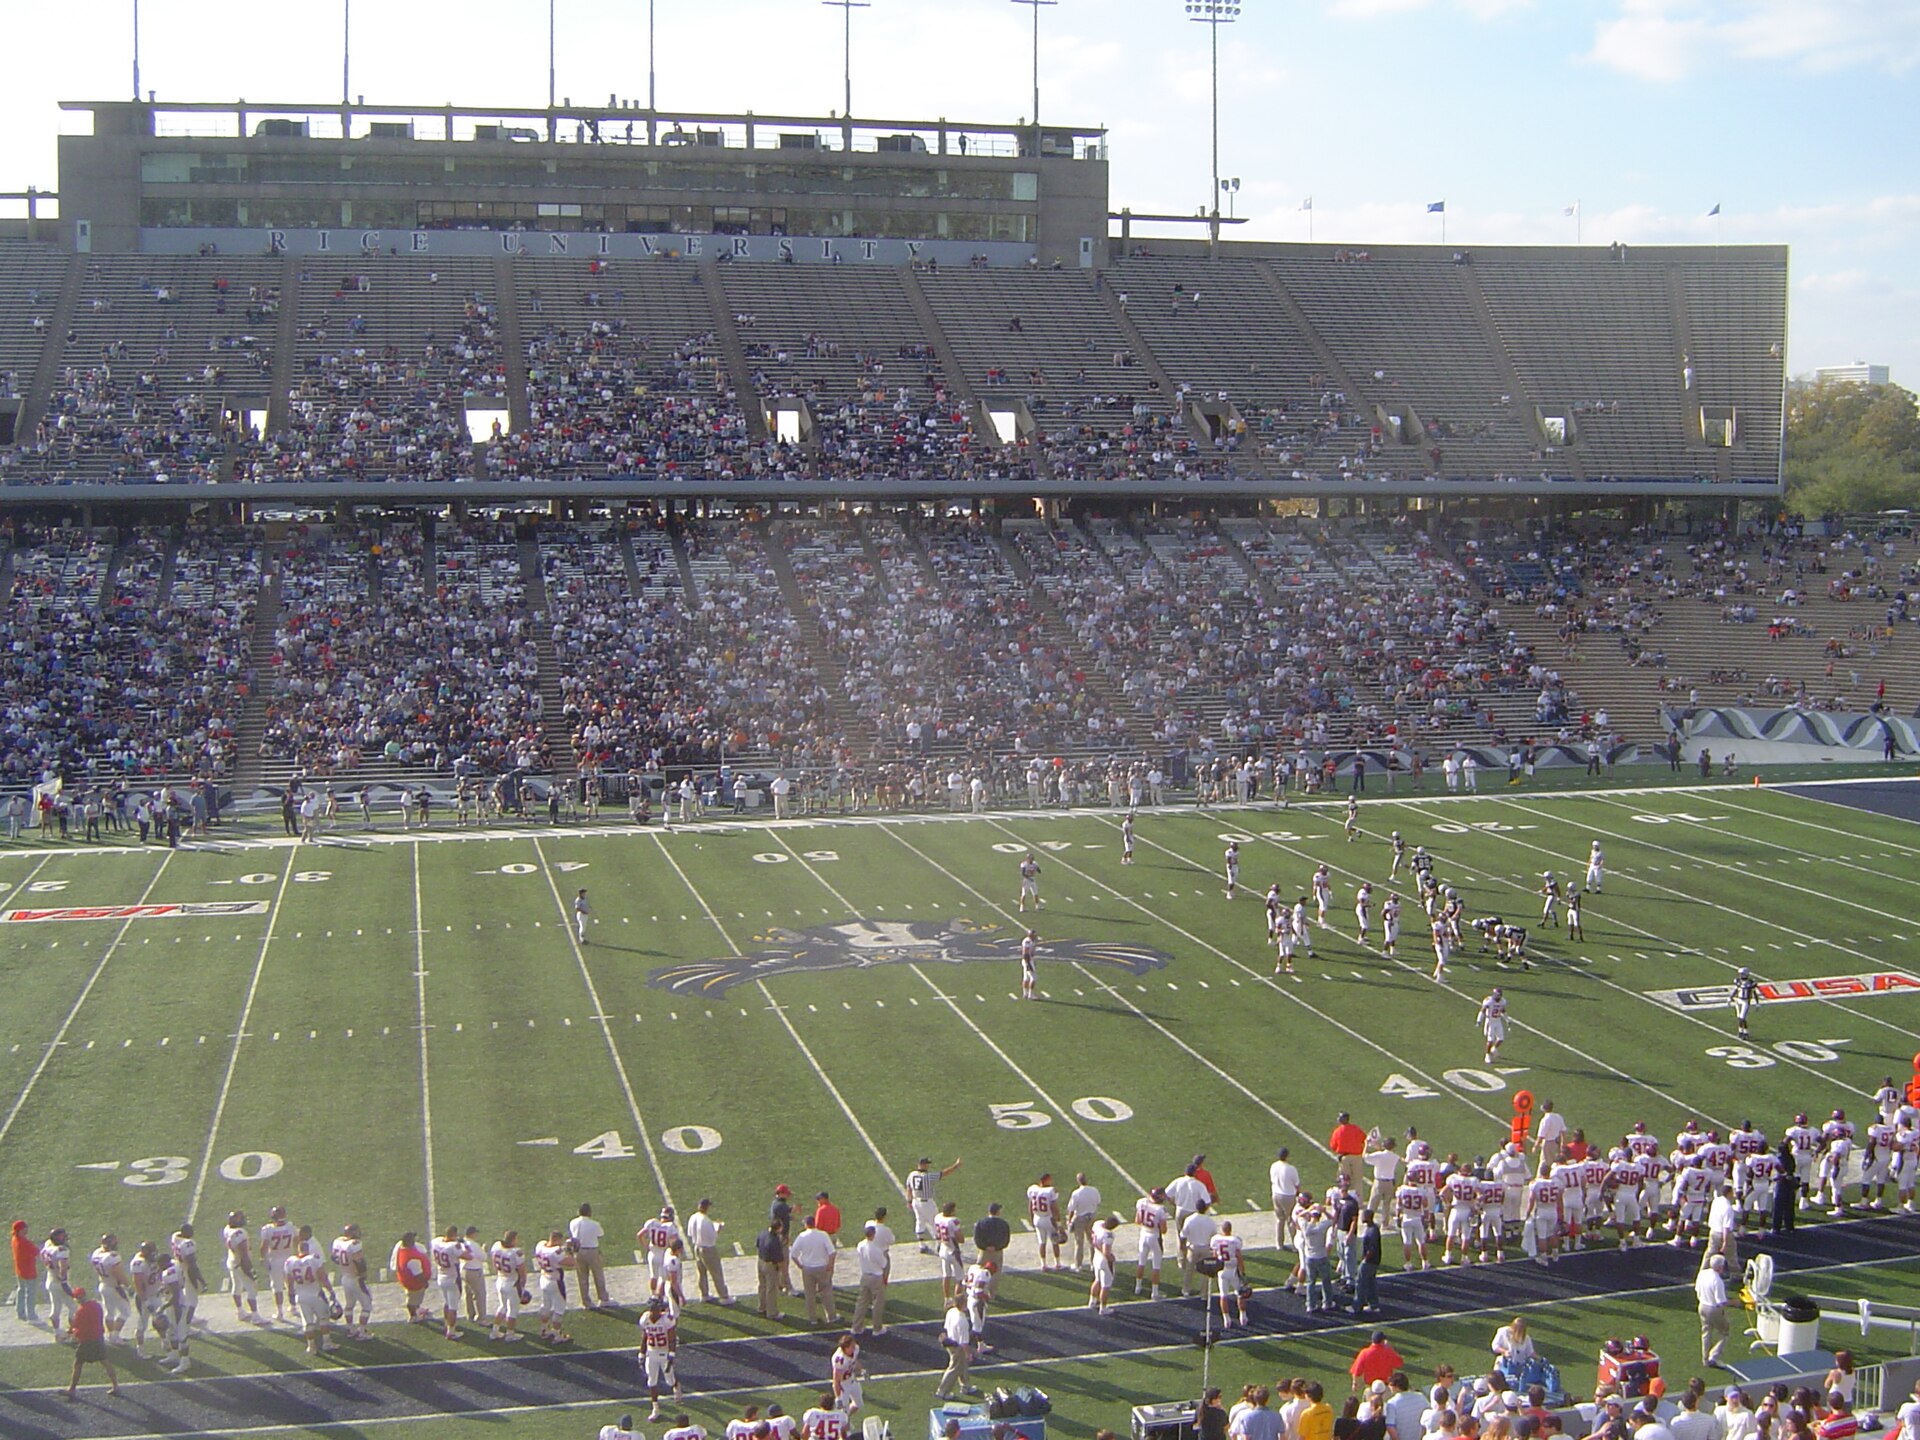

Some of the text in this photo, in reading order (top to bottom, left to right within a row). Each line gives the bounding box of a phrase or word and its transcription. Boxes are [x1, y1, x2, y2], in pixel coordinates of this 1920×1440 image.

[267, 230, 925, 260] RICE UNIVERSITY
[1704, 1040, 1839, 1069] 30
[1378, 1068, 1507, 1099] 40
[987, 1096, 1134, 1131] 50
[572, 1125, 723, 1159] 40
[123, 1151, 284, 1186] 30
[1709, 1151, 1726, 1166] 43
[1140, 1208, 1154, 1228] 15
[271, 1234, 292, 1250] 77
[650, 1228, 667, 1248] 18
[815, 1420, 840, 1440] 45
